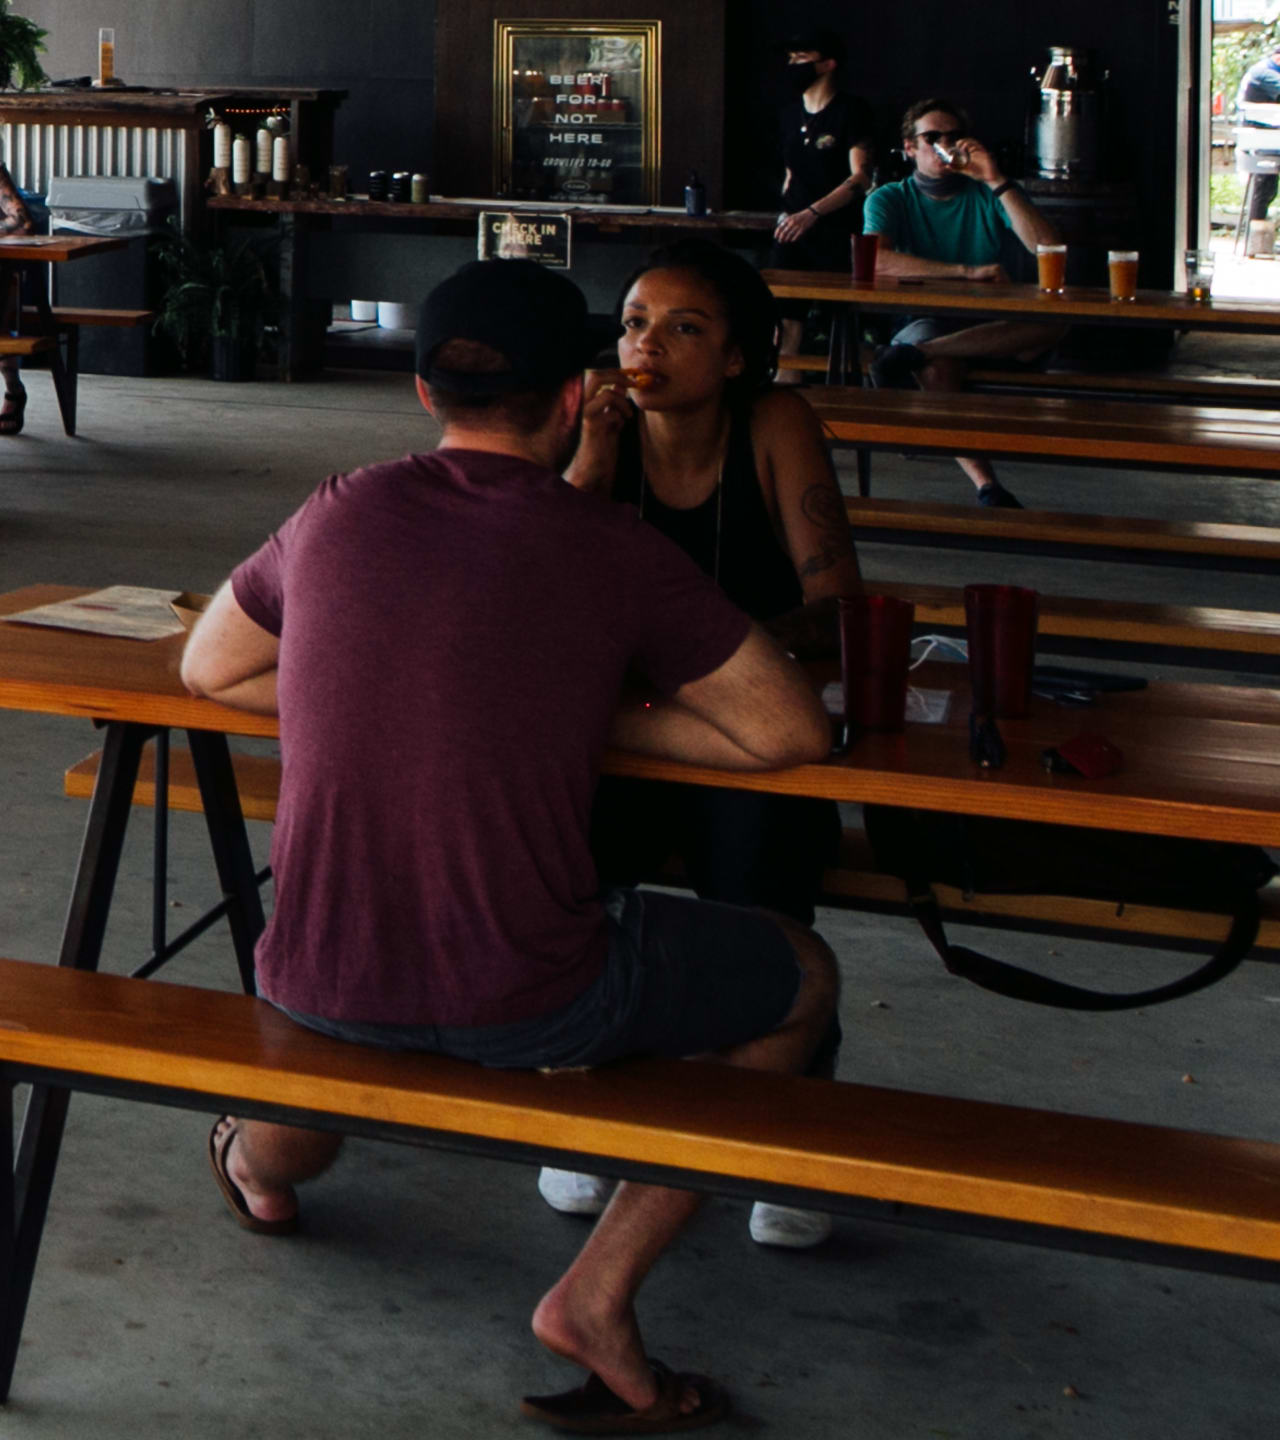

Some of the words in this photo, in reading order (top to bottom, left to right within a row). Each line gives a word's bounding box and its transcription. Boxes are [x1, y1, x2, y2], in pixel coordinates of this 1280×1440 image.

[549, 74, 603, 85] BEER
[556, 94, 597, 105] FOR
[555, 113, 598, 124] NOT
[549, 133, 603, 144] HERE
[492, 222, 538, 235] CHECK
[540, 224, 557, 236] IN
[506, 233, 543, 246] HERE
